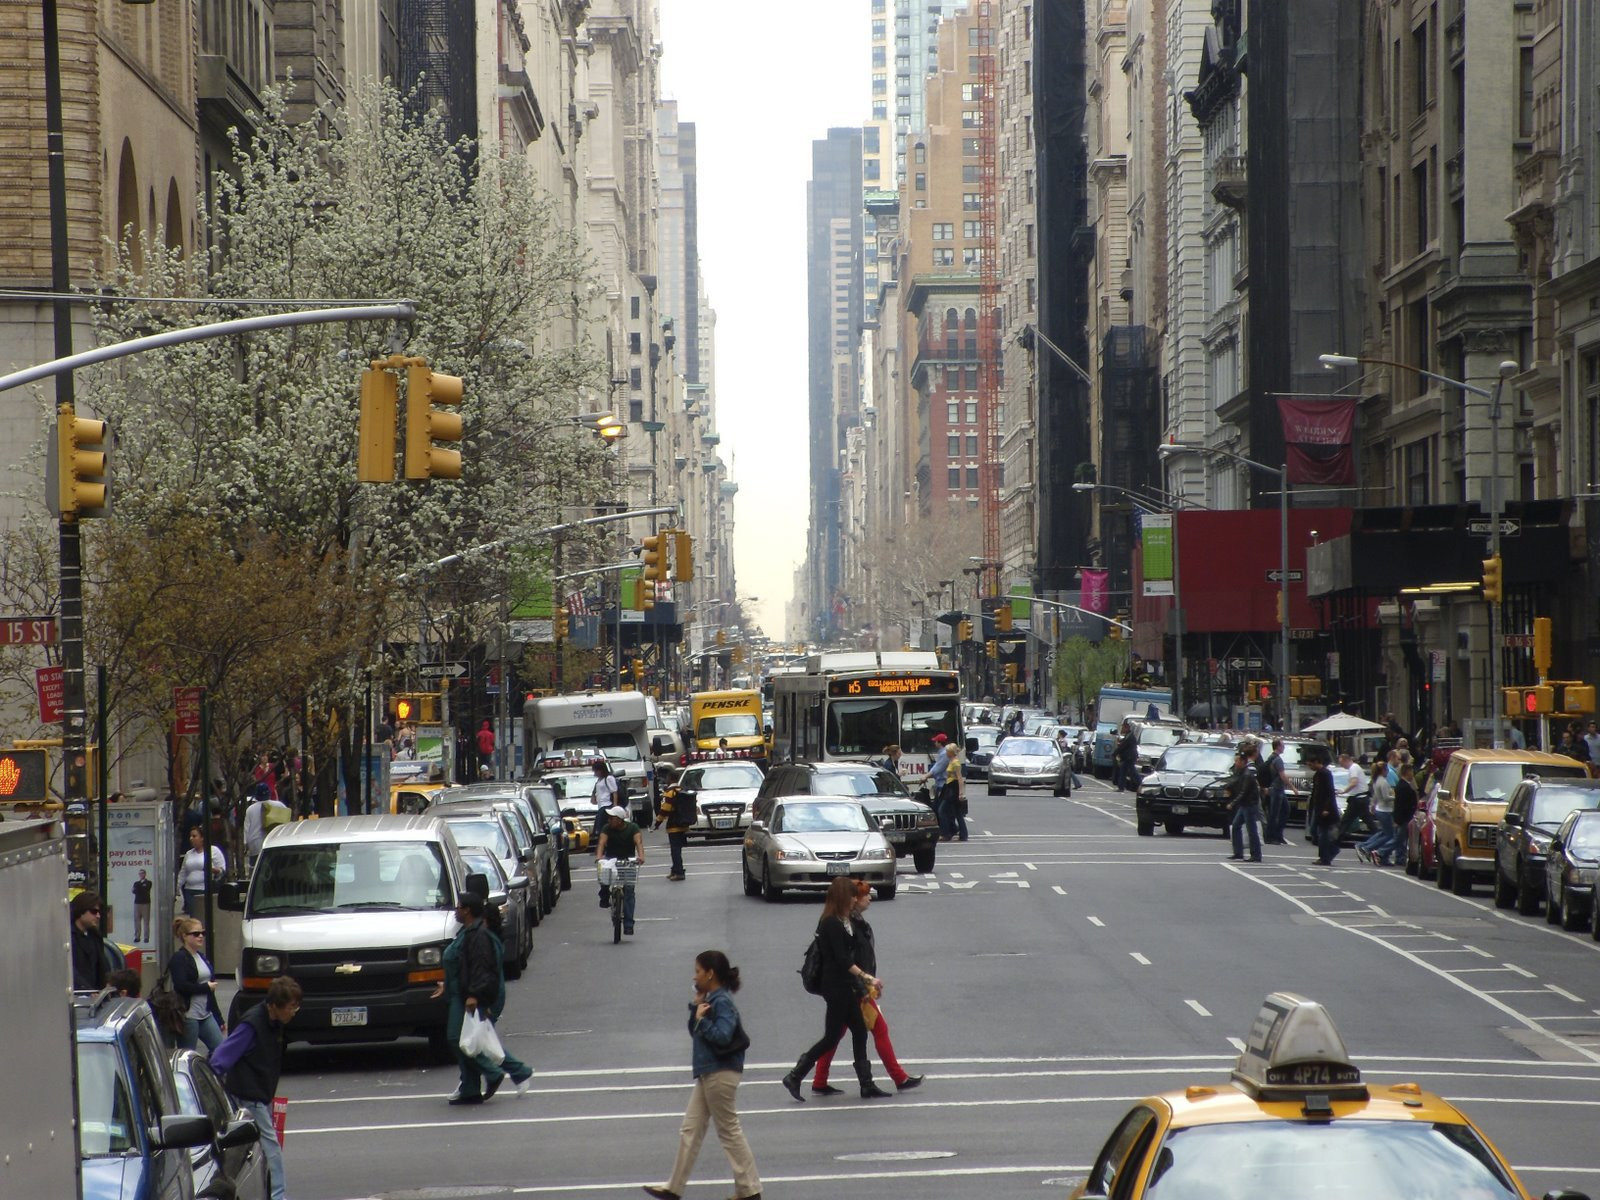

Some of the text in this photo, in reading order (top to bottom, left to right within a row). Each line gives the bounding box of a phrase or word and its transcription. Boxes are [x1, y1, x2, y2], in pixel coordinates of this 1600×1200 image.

[1475, 523, 1489, 531] ONE
[8, 621, 49, 643] 15 ST
[847, 680, 861, 693] M5
[905, 678, 931, 686] VILLAGE
[702, 699, 751, 709] PENSKE
[108, 811, 141, 819] hone
[109, 850, 123, 858] pay
[139, 847, 152, 856] the
[111, 860, 127, 869] you
[129, 859, 143, 867] use
[1295, 1066, 1330, 1084] 4P74
